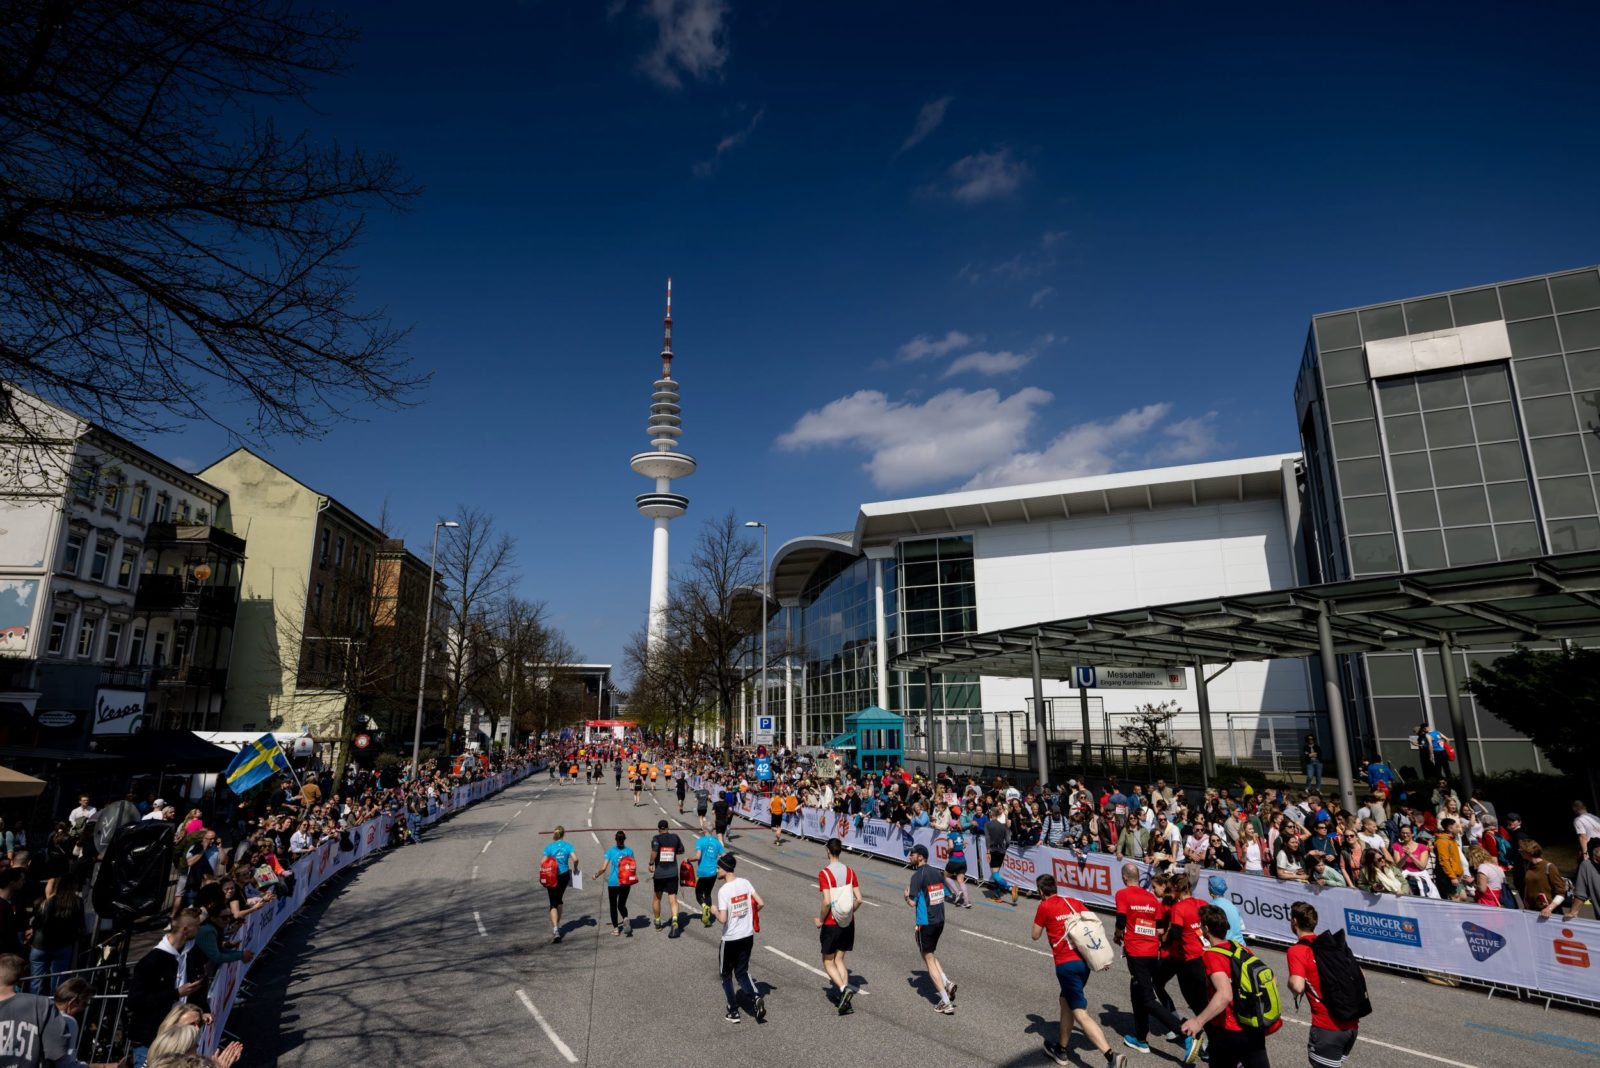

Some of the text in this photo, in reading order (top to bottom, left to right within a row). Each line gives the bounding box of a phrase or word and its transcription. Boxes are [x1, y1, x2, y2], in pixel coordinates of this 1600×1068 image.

[1079, 668, 1094, 687] U
[1107, 670, 1155, 679] Messehallen
[1100, 679, 1122, 687] Eingang
[96, 695, 142, 724] Vespa
[762, 719, 770, 728] P
[757, 763, 769, 772] 42
[863, 824, 887, 838] VITAMIN
[863, 834, 878, 847] WELL
[936, 845, 948, 860] LB
[1003, 855, 1035, 874] Haspa
[1055, 862, 1108, 891] REWE
[1231, 892, 1291, 922] Polest
[1348, 912, 1402, 932] ERDINGER
[1349, 924, 1417, 940] ALKOHOLFREI
[1469, 937, 1500, 948] ACTIVE
[1471, 944, 1490, 954] CITY
